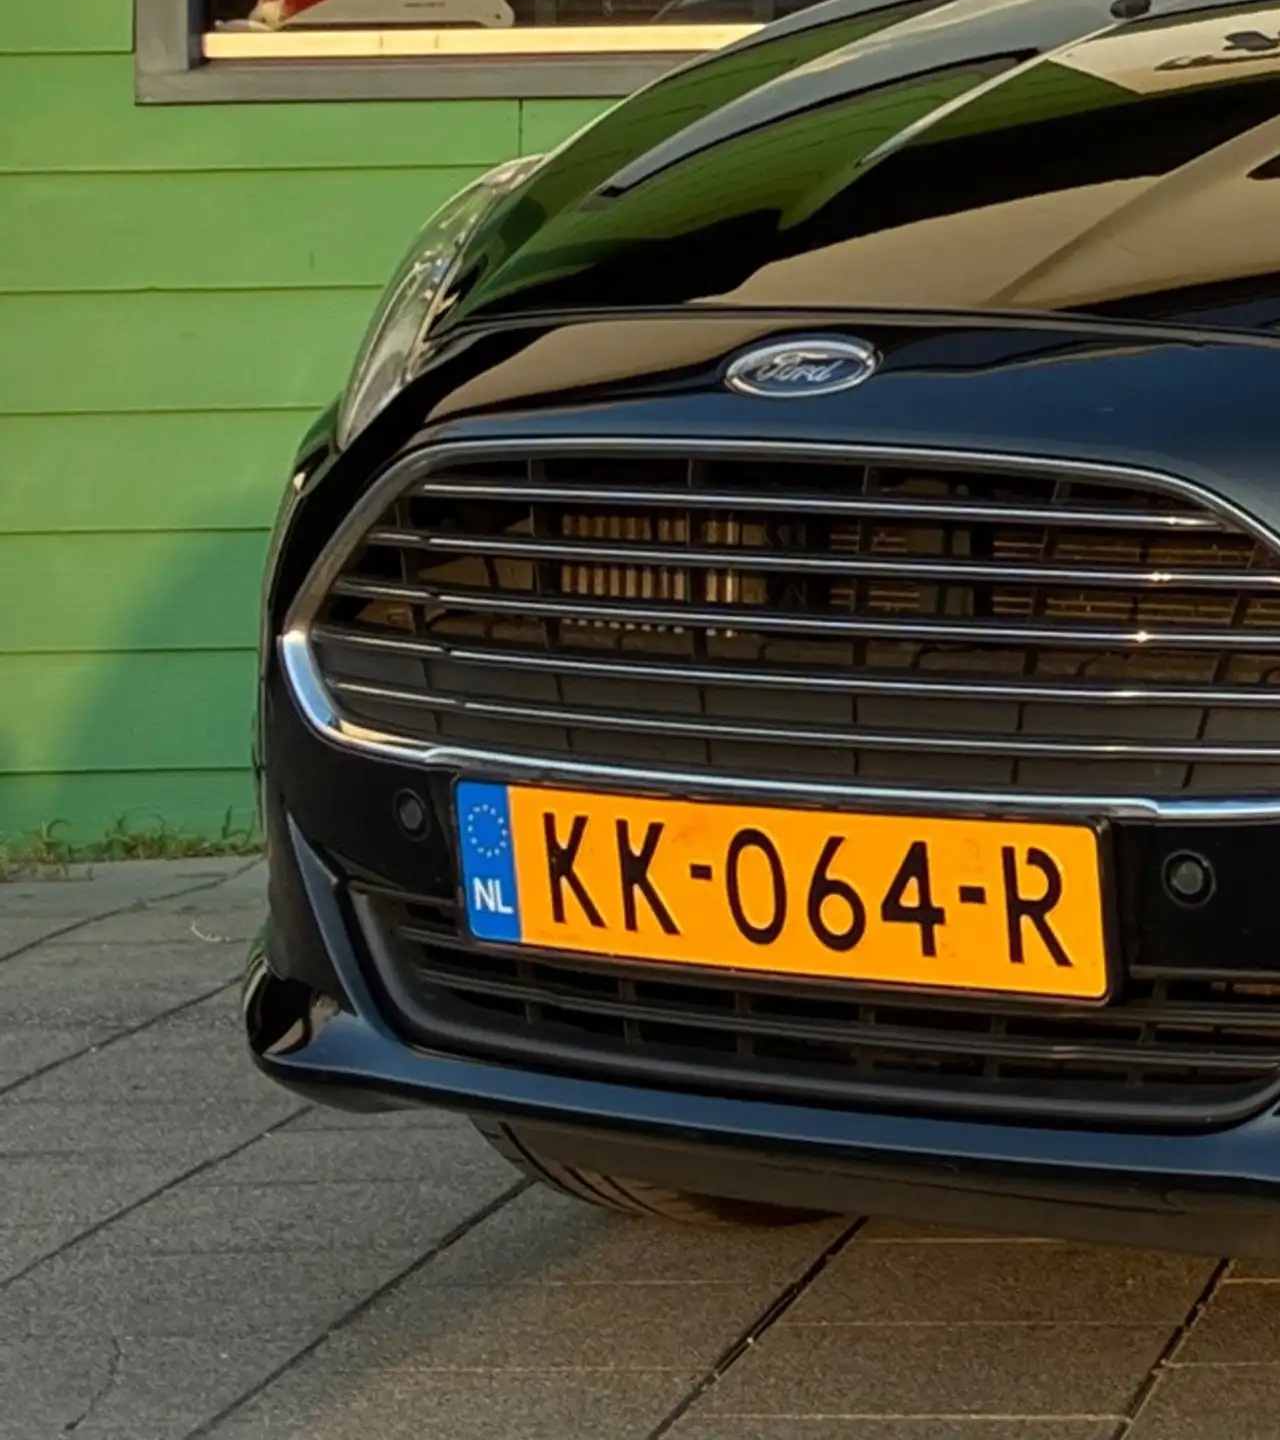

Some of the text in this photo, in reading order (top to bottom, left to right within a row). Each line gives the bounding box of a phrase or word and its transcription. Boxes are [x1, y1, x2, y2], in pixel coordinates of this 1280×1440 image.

[755, 351, 844, 382] Ford
[472, 877, 514, 915] NL
[542, 811, 1074, 968] KK-064-R
